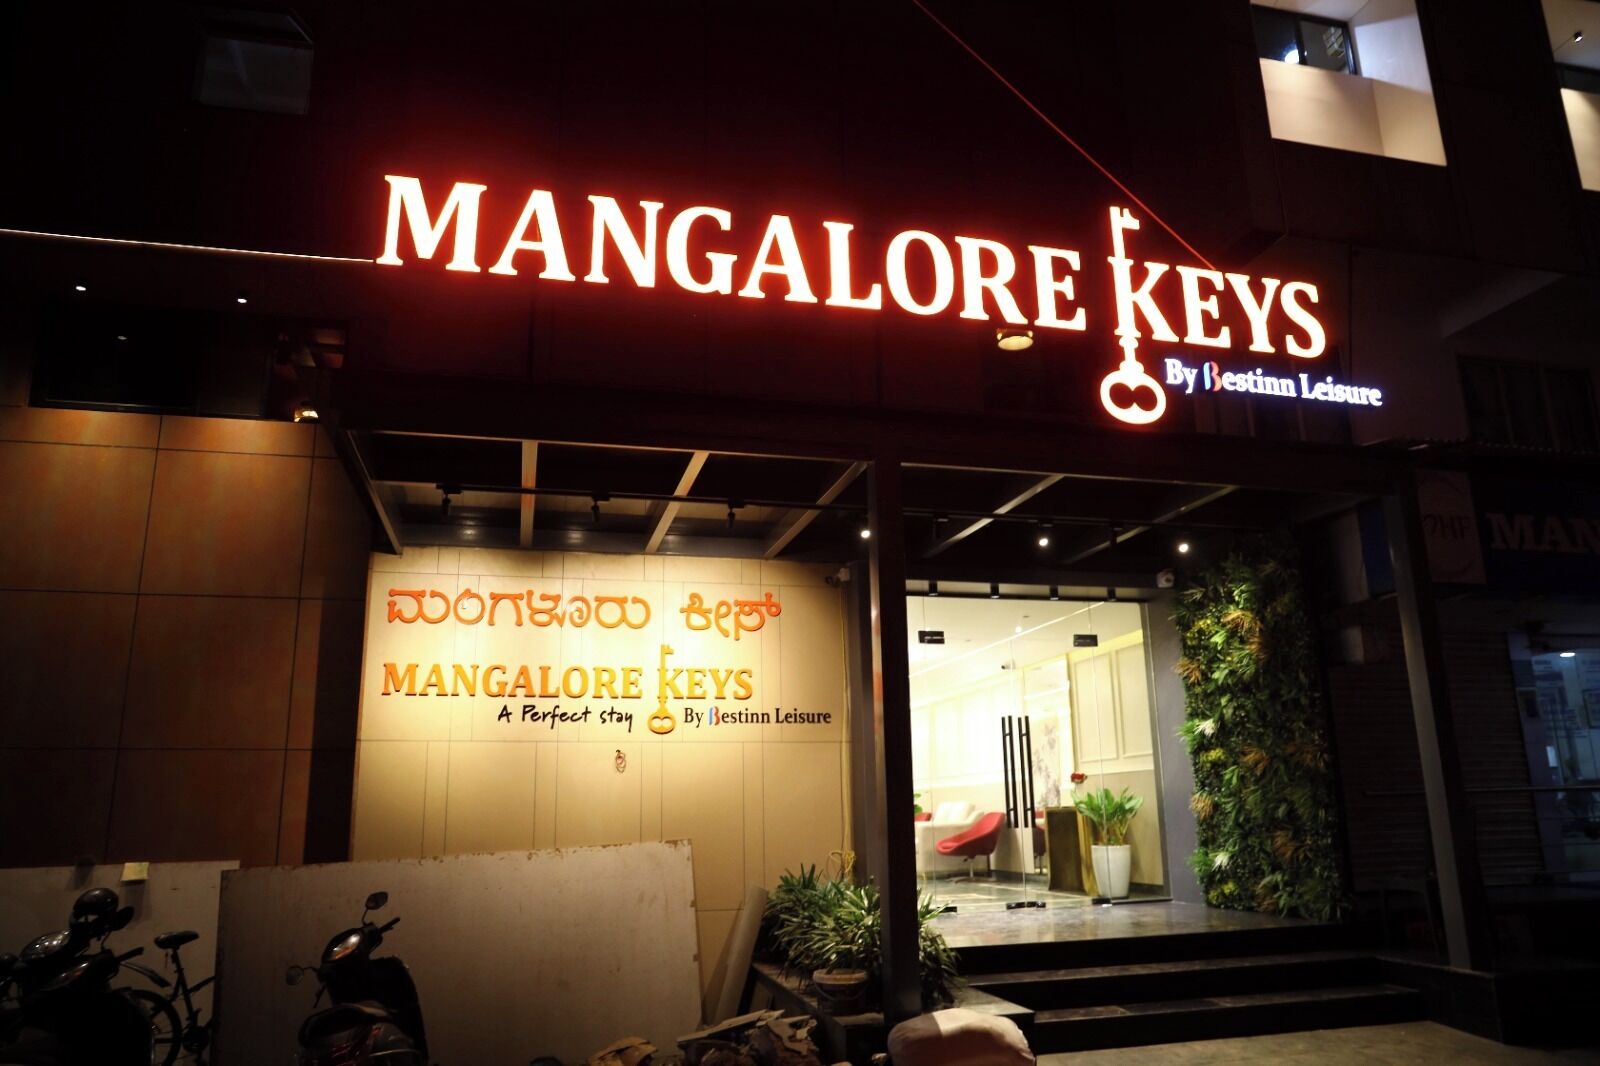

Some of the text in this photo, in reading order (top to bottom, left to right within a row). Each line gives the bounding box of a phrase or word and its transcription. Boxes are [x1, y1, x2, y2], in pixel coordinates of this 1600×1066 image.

[376, 174, 1327, 359] MANGALORE KEYS
[1164, 358, 1383, 406] By Bestinn Leisure
[387, 588, 651, 630] ಮಂಗಳೂರು
[381, 662, 753, 701] MANGALORE KEYS
[497, 704, 633, 733] A Perfect stay
[684, 706, 832, 728] By Bestinn Leisure
